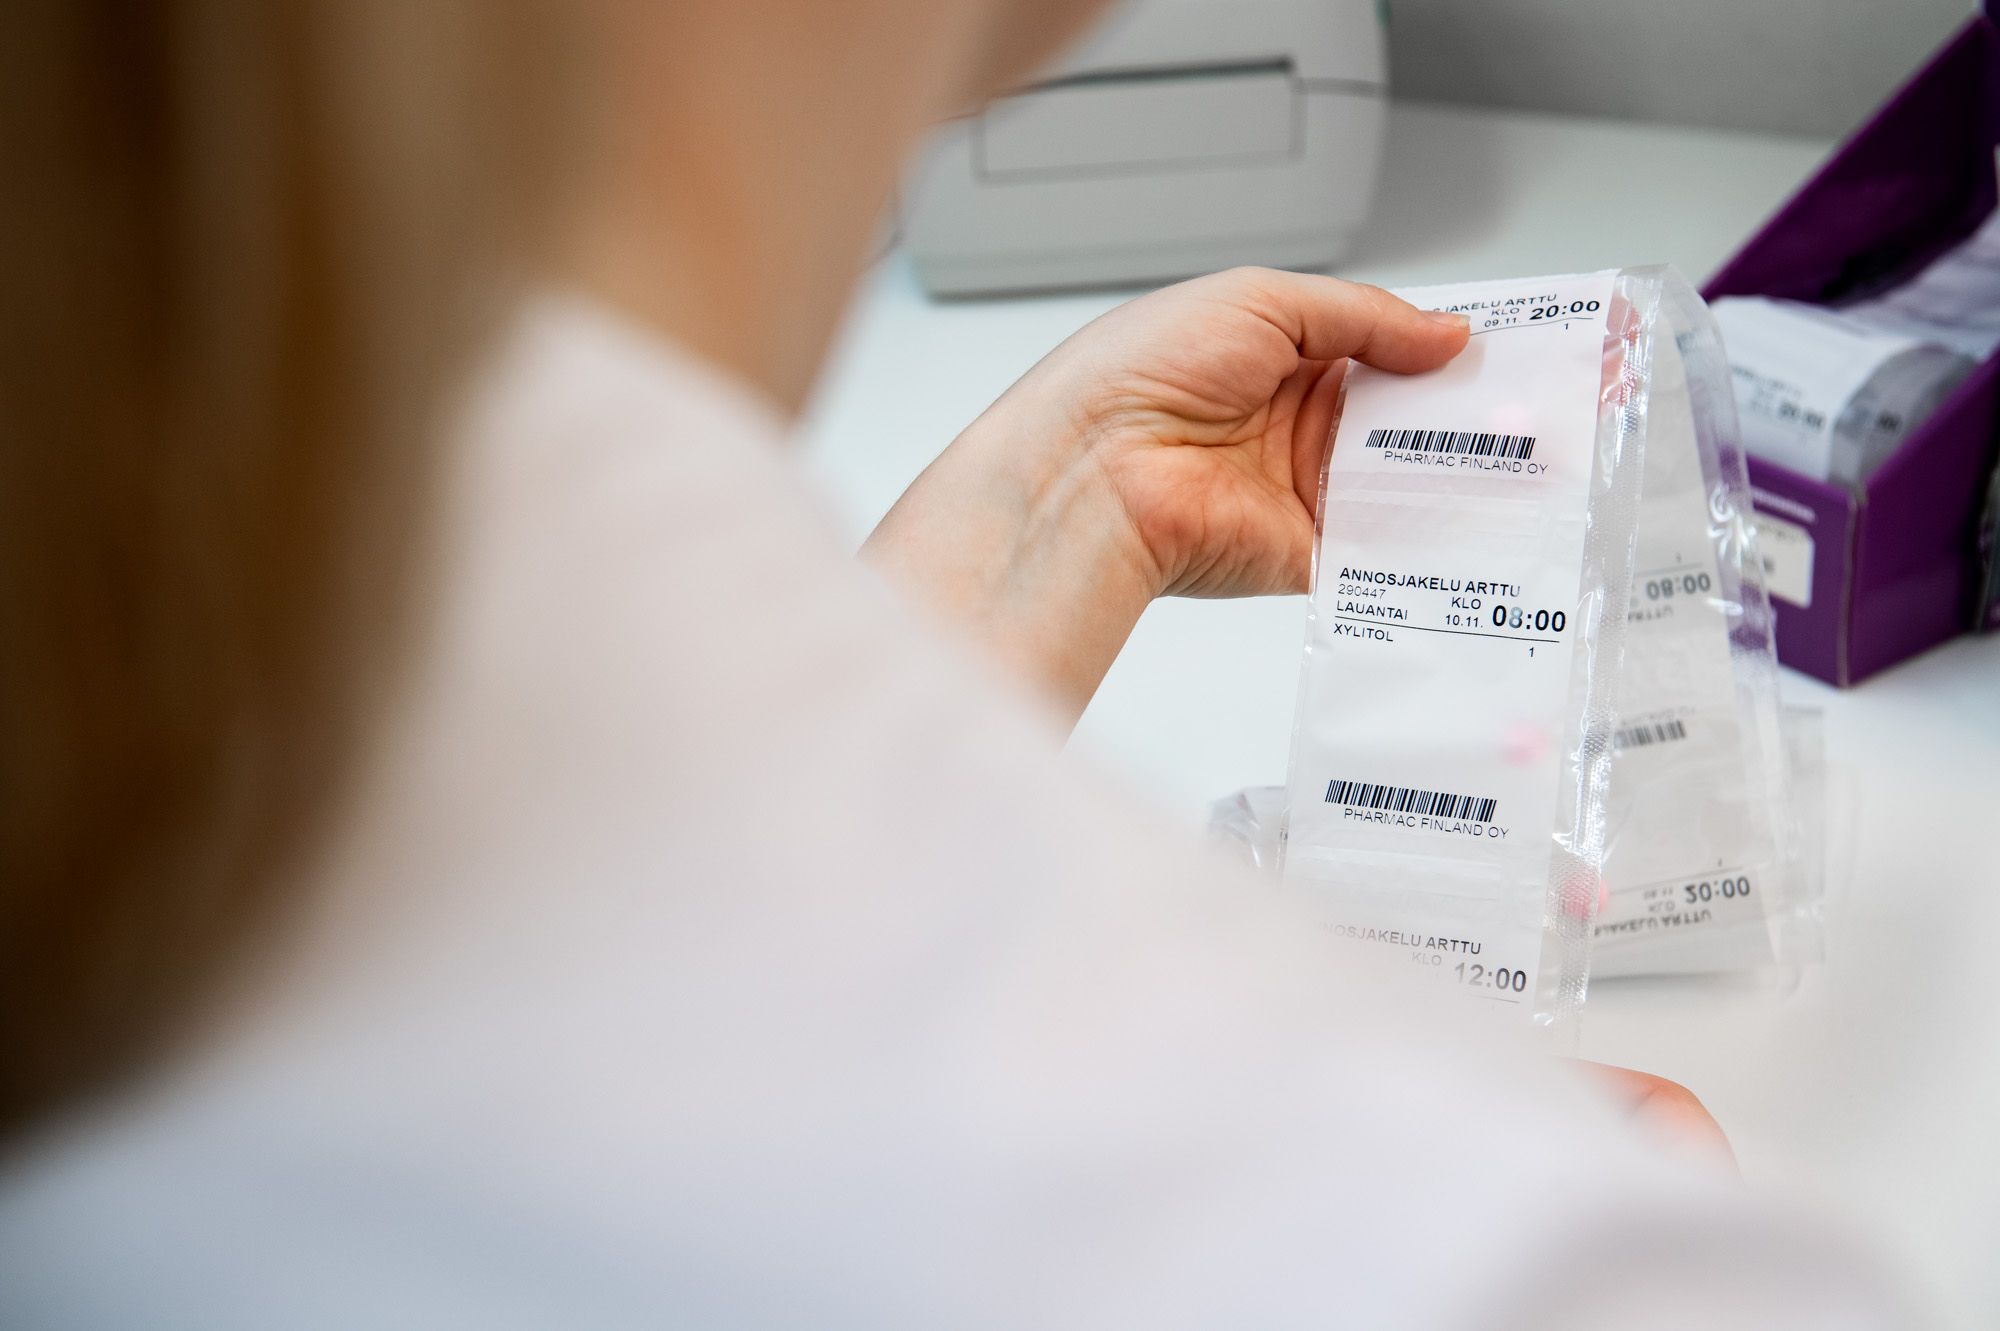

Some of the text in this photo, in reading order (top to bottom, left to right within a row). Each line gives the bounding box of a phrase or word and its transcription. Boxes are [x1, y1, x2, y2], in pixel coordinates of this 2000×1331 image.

[1504, 294, 1558, 306] ARTTU
[1491, 307, 1520, 317] KLO
[1529, 300, 1600, 321] 20:00
[1564, 322, 1569, 331] 1
[1384, 450, 1549, 475] PHARMAC FINLAND OY
[1339, 567, 1521, 598] ANNOSJAKELU ARTTU
[1337, 583, 1482, 610] 290447 KLO
[1336, 600, 1566, 632] LAUANTAI 10.11. 08:00
[1333, 623, 1394, 642] XYLITOL
[1528, 646, 1535, 658] 1
[1344, 808, 1510, 839] PHARMAC FINLAND OY
[1425, 936, 1482, 955] ARTTU
[1411, 951, 1442, 967] KLO
[1454, 961, 1527, 993] 12:00
